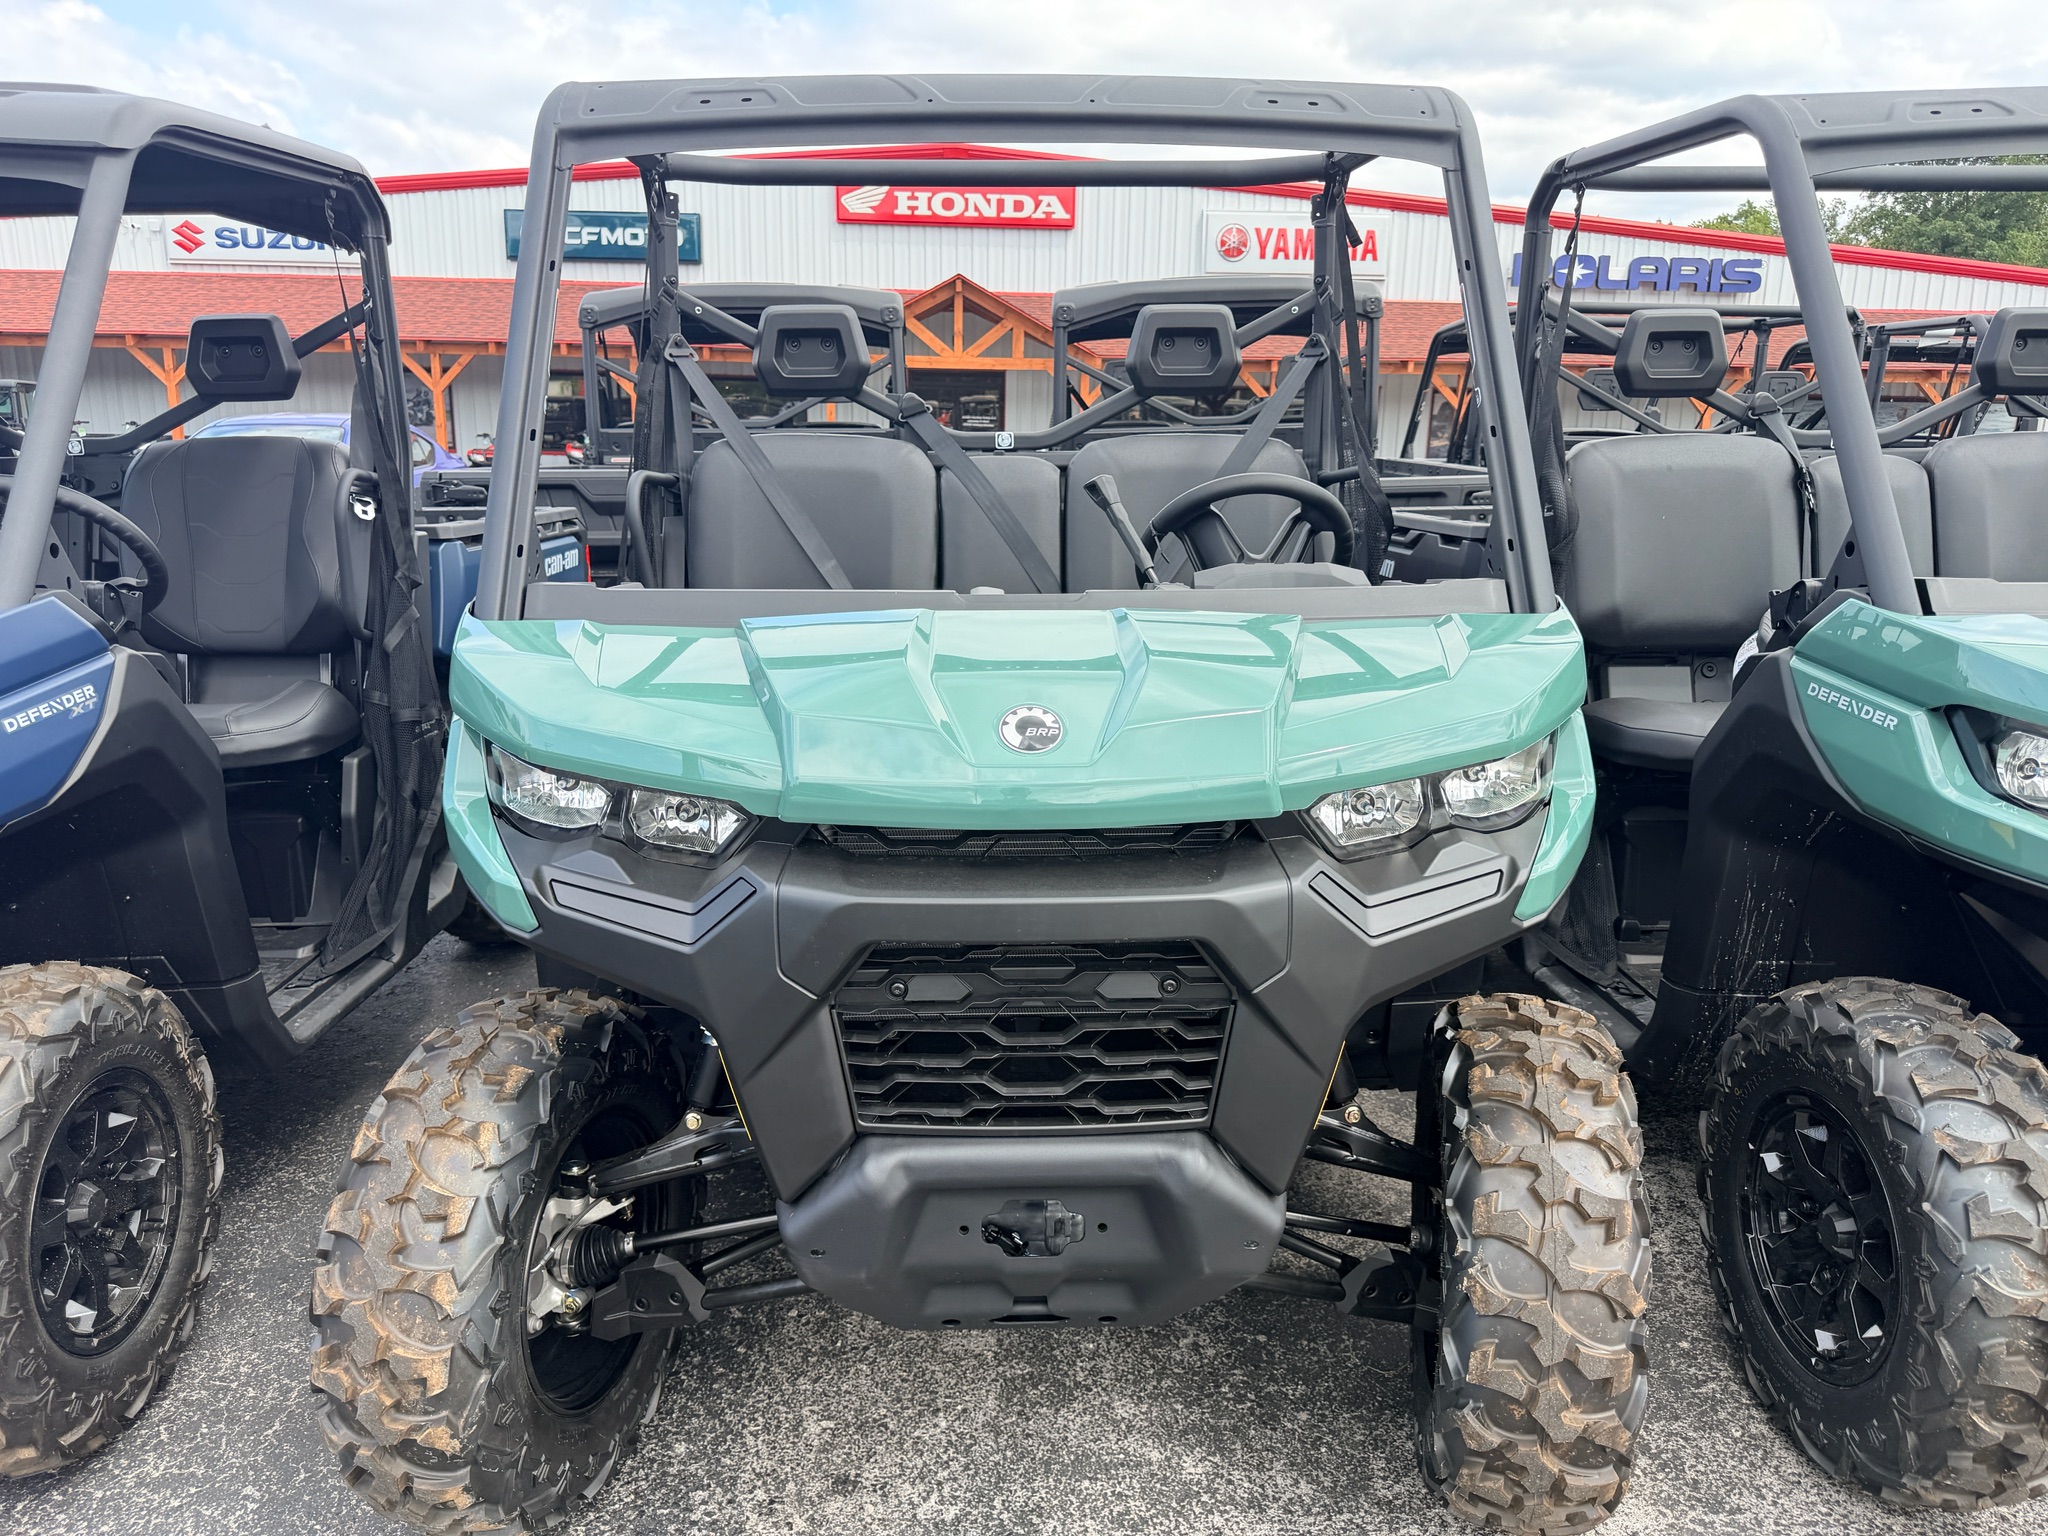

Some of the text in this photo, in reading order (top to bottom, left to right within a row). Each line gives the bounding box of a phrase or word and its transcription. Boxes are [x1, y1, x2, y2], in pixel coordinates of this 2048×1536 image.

[894, 190, 1070, 219] HONDA
[214, 226, 326, 250] SUZU
[564, 226, 684, 247] CFMO
[1254, 227, 1378, 261] YAMA
[544, 548, 579, 577] can-am
[3, 684, 96, 733] DEFENDER
[69, 698, 97, 719] XT
[1807, 682, 1899, 731] DEFENDER
[1025, 727, 1060, 737] BRP
